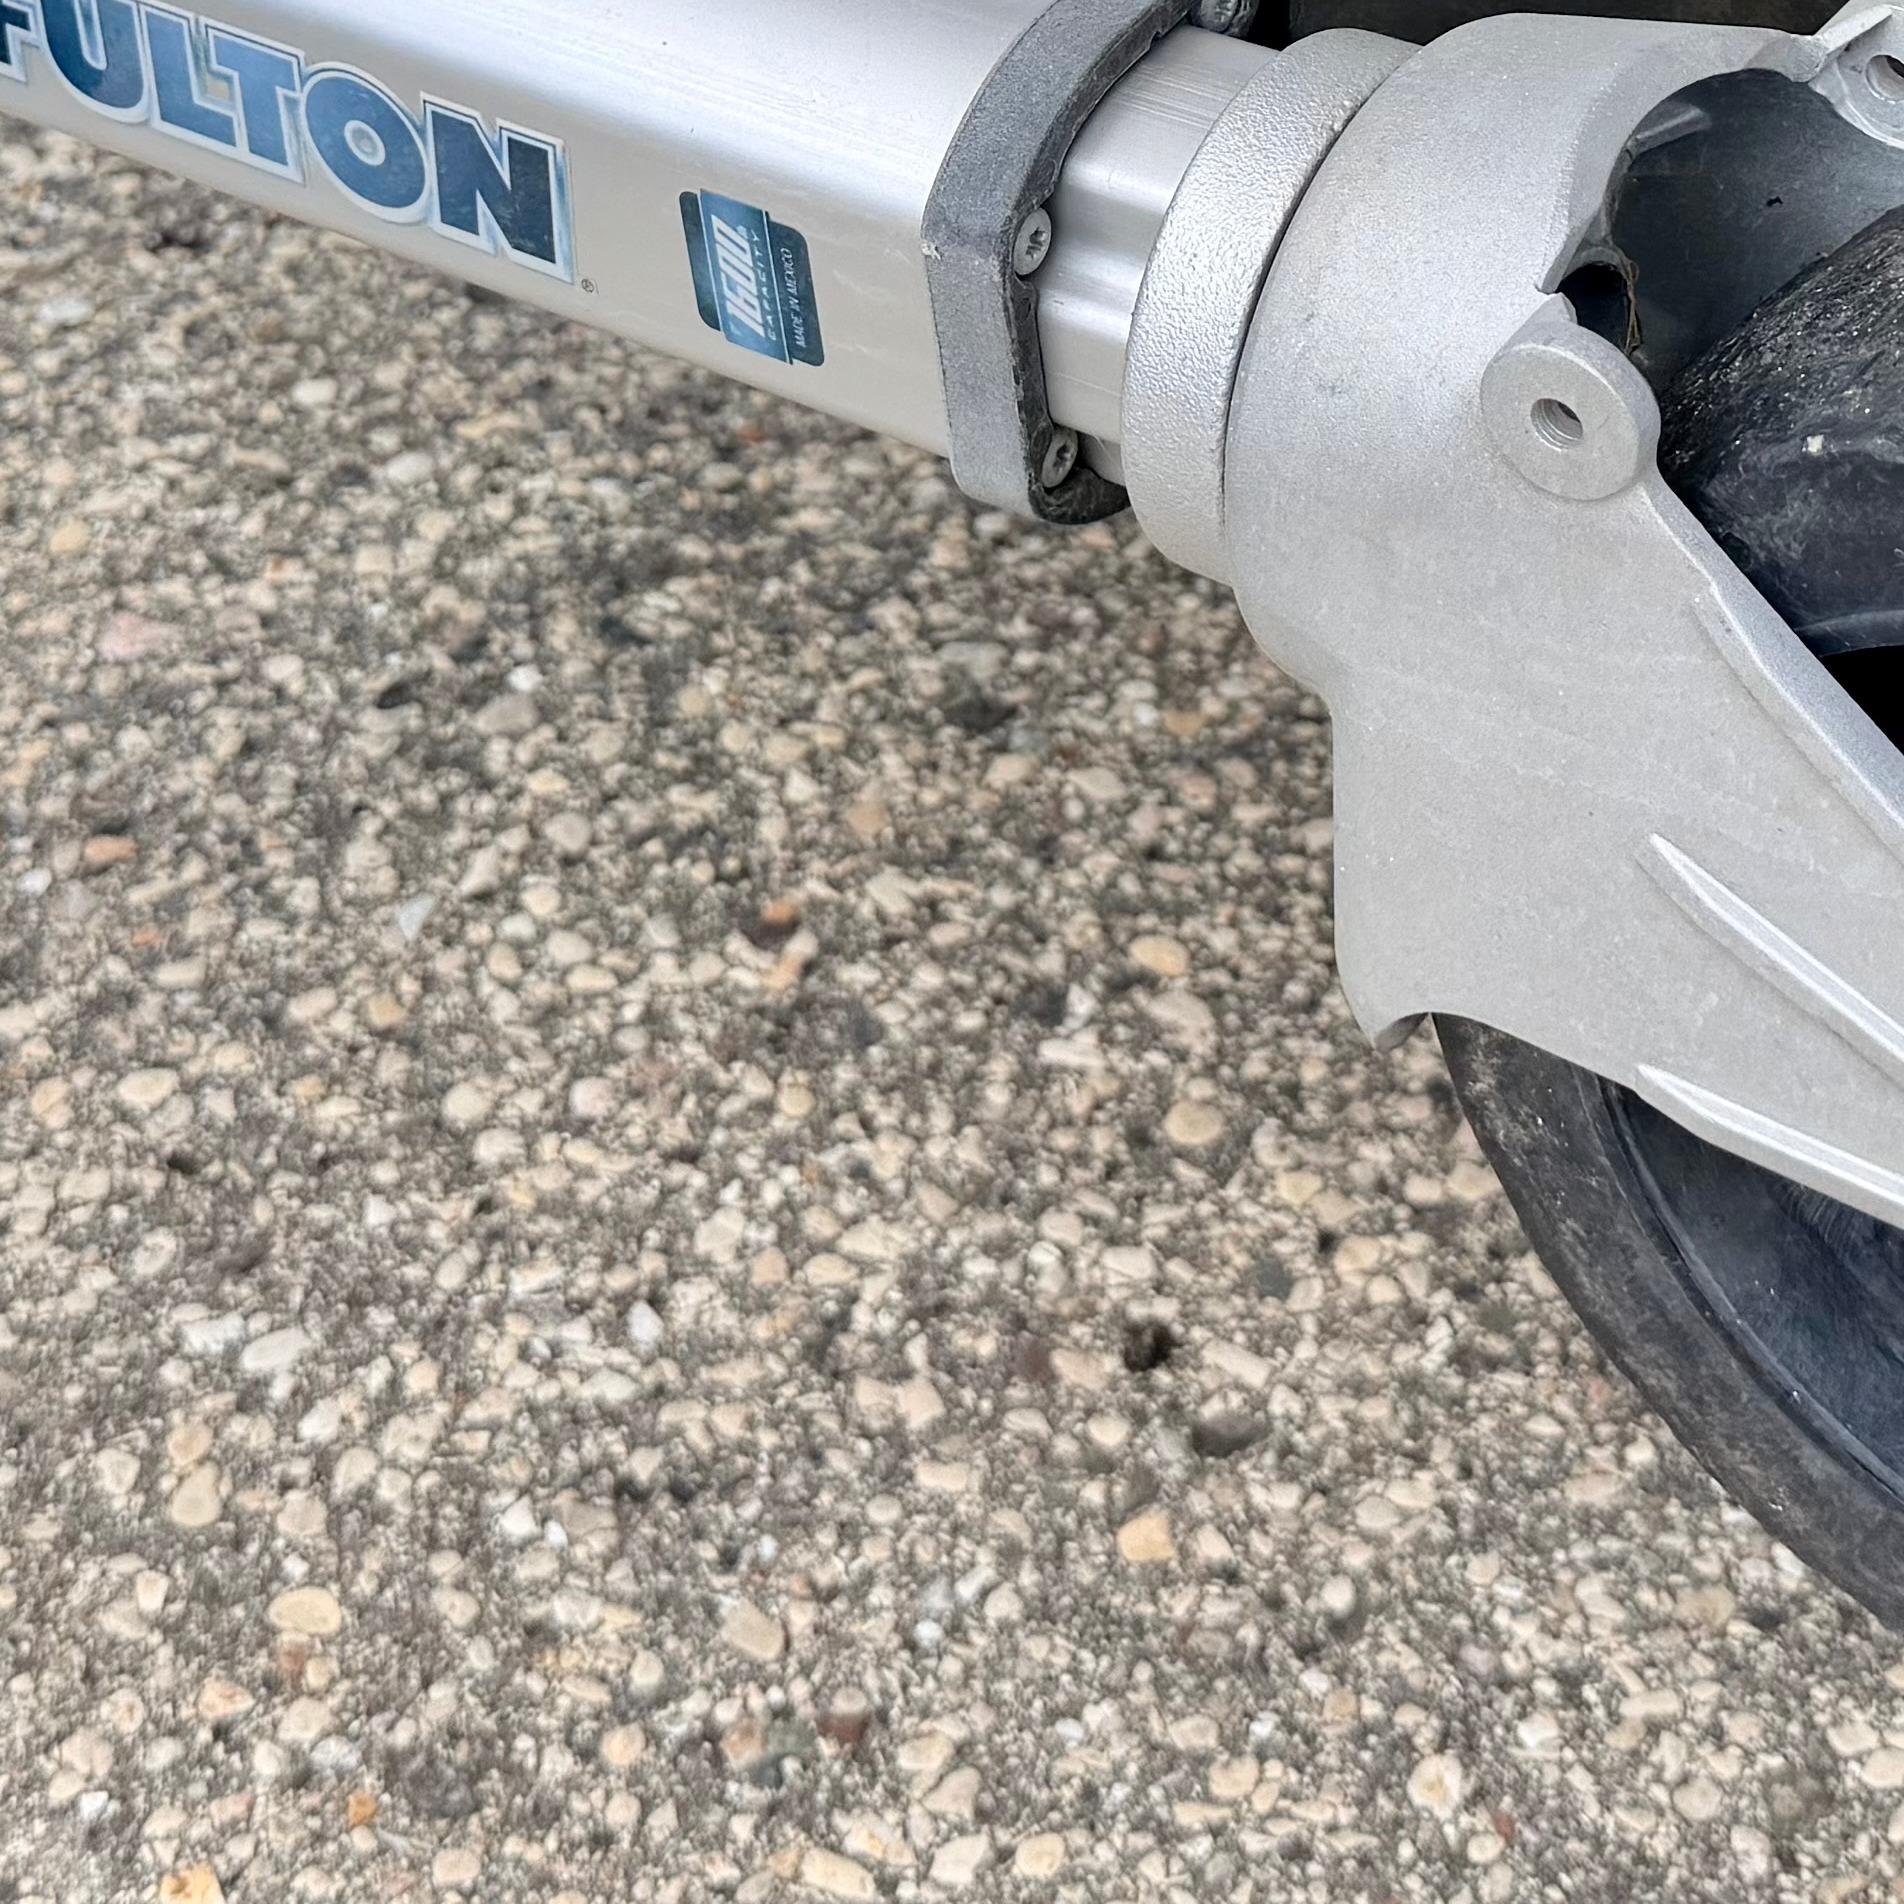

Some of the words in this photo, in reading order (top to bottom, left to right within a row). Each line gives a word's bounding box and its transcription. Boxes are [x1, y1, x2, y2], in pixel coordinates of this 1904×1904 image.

[711, 214, 765, 338] 1600
[751, 229, 777, 341] CAPACITY
[780, 246, 798, 296] MEXICO
[788, 296, 799, 312] IN
[791, 313, 807, 349] MADE
